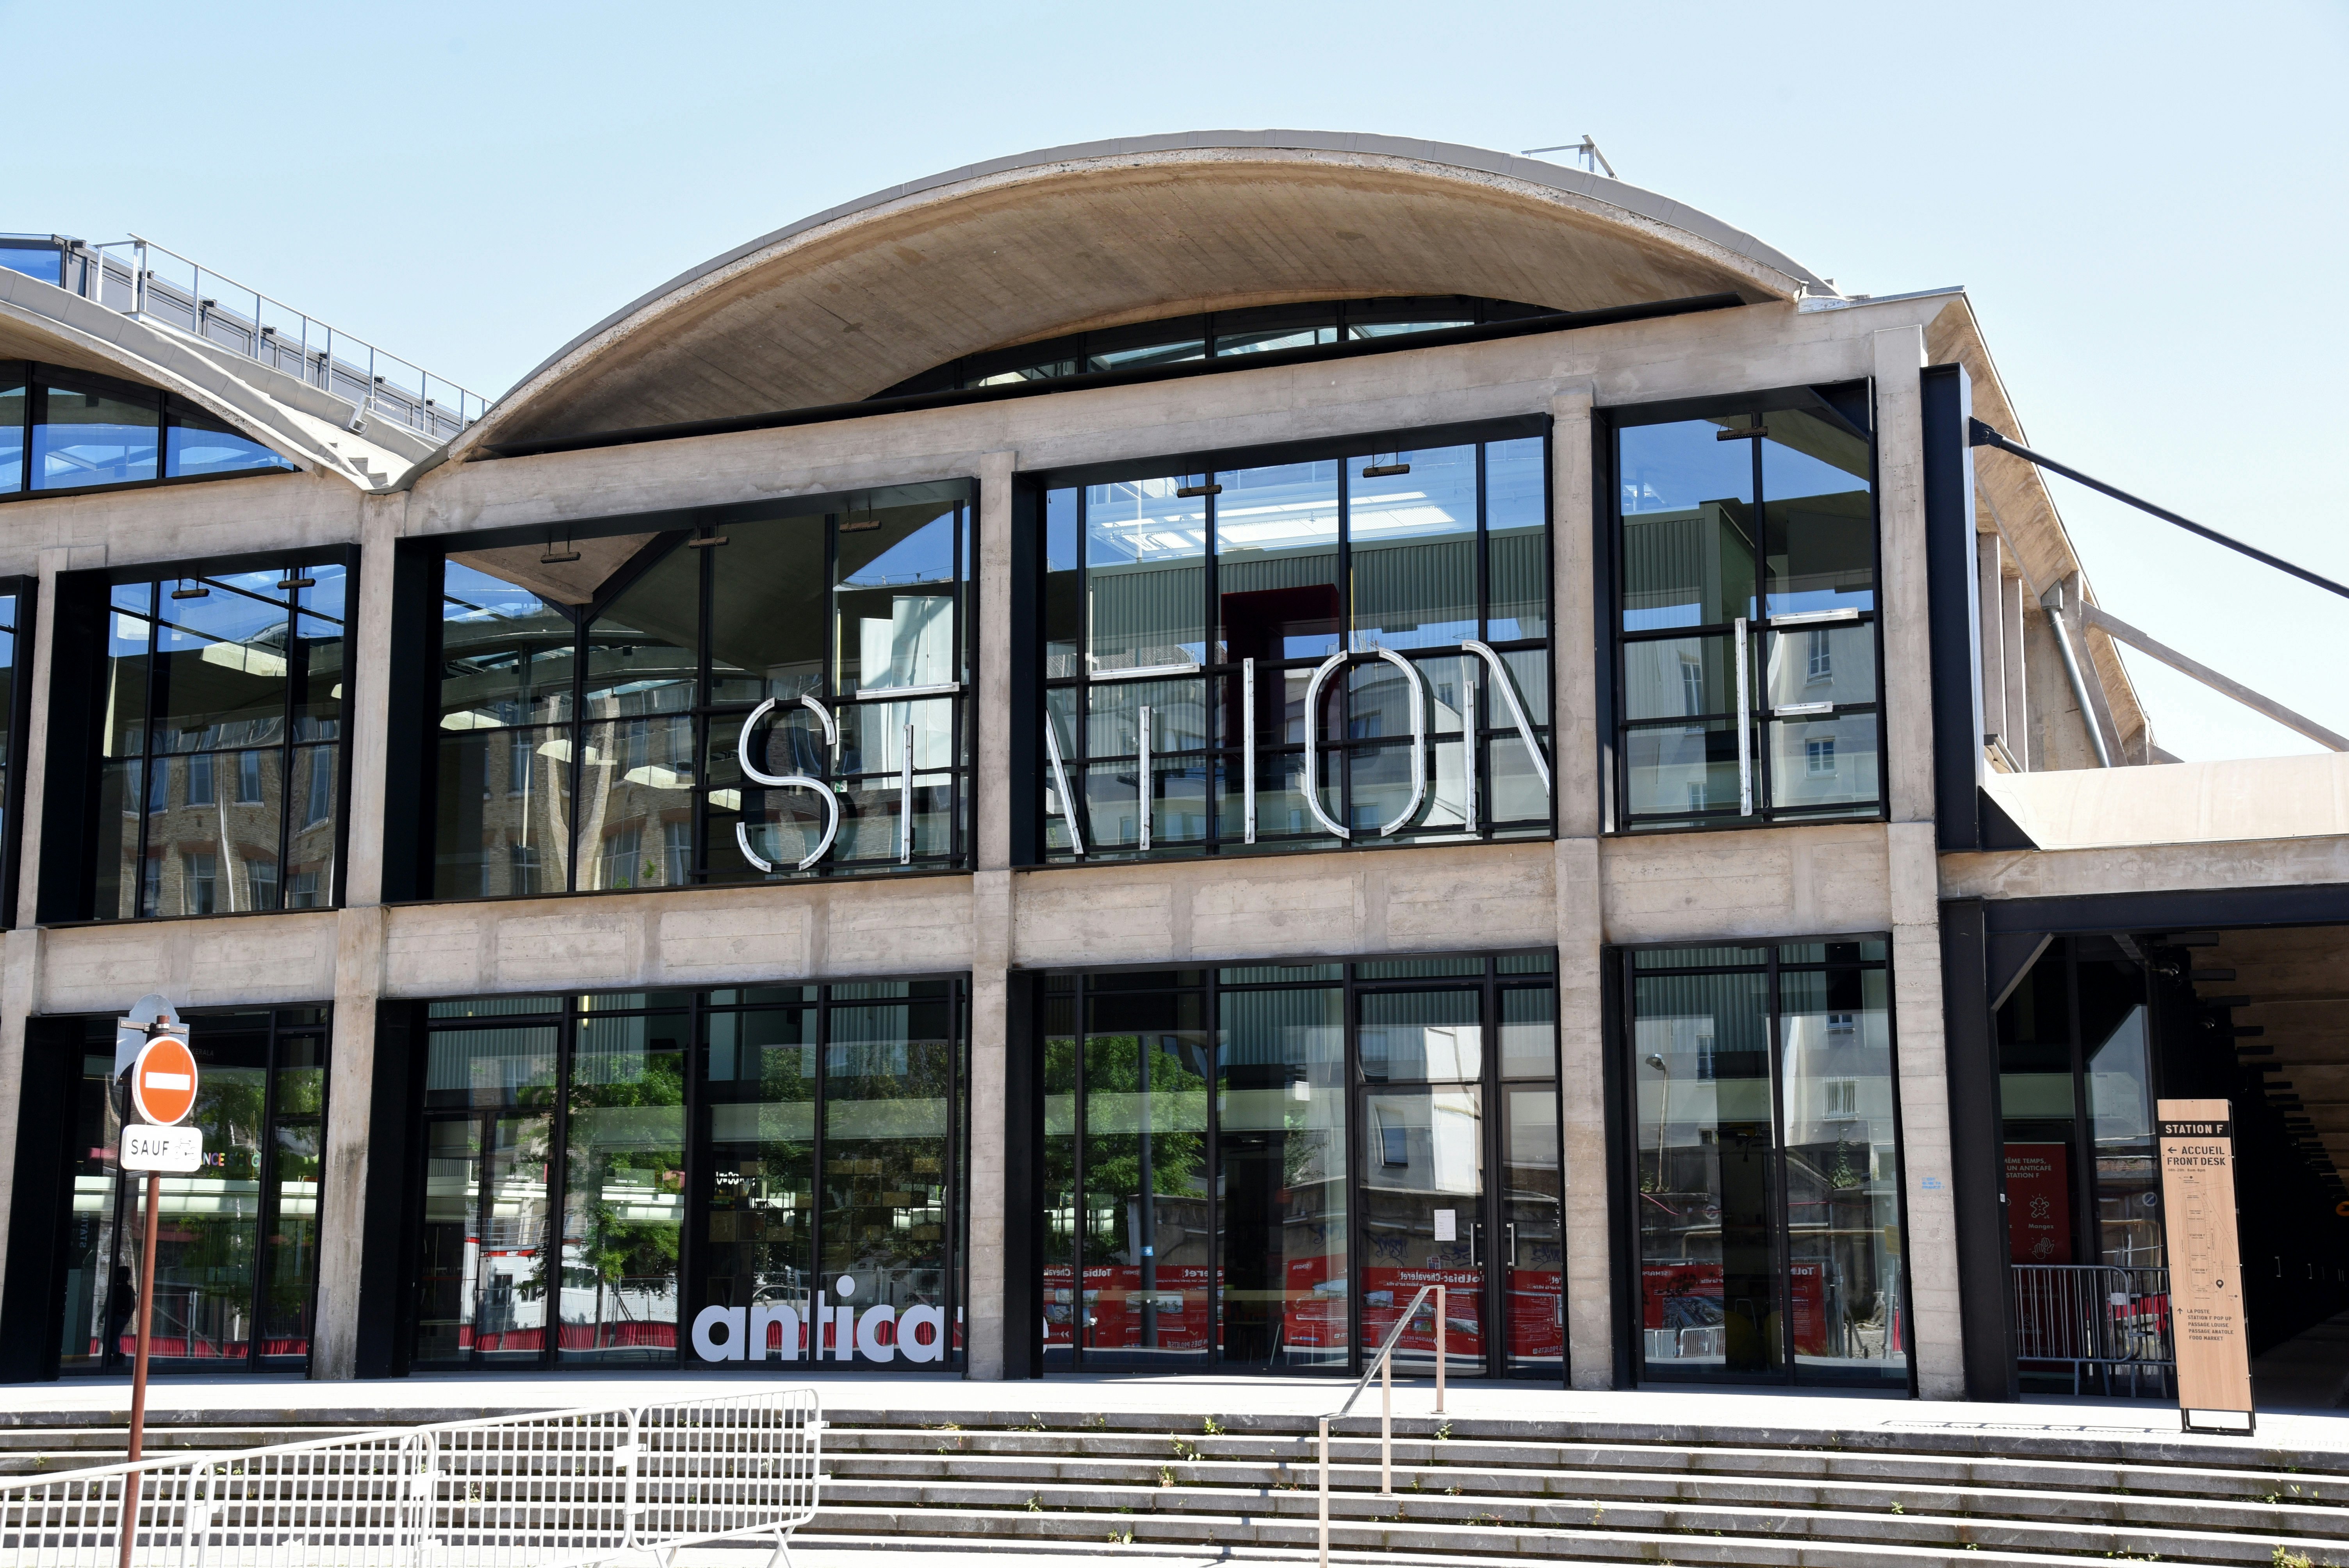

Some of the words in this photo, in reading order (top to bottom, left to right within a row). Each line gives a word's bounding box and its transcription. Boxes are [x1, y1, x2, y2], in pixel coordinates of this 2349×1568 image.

[1735, 608, 1859, 816] F
[2165, 1124, 2212, 1133] STATION
[2217, 1124, 2223, 1133] F
[131, 1139, 169, 1156] SAUF
[2181, 1146, 2225, 1155] ACCUEIL
[200, 1152, 225, 1167] NCE
[2167, 1157, 2198, 1165] FRONT
[2201, 1157, 2226, 1165] DESK
[692, 1275, 963, 1363] antica
